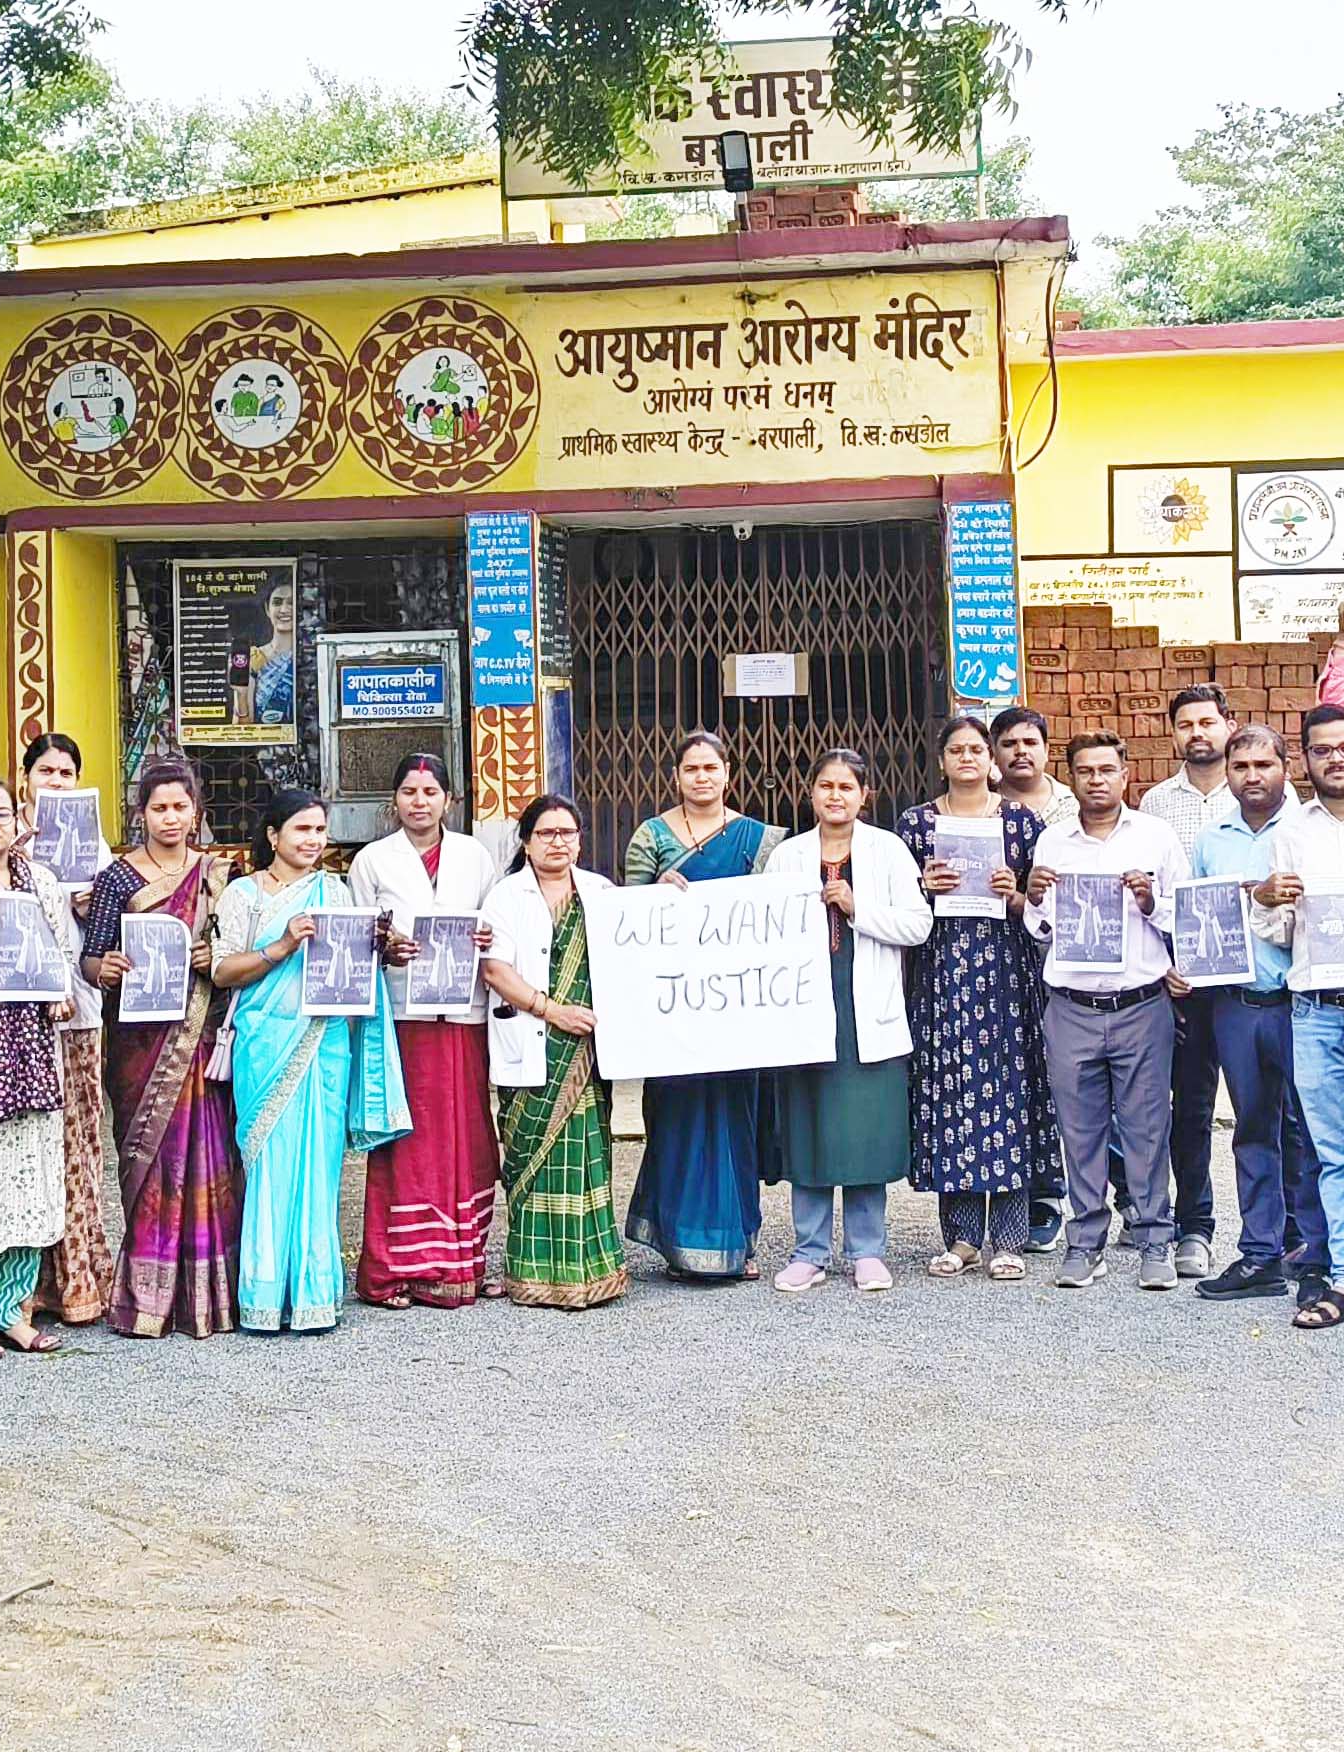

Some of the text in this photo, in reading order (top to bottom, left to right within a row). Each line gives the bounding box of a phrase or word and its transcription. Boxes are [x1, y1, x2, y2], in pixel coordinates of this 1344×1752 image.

[554, 292, 972, 393] आयुष्मान आरोग्य मंदिर
[643, 377, 713, 416] आरोग्यं
[784, 380, 837, 414] धनम्
[558, 427, 618, 460] प्राथमिक
[621, 430, 683, 453] स्वास्थ्य
[687, 421, 729, 457] केन्द्र
[347, 667, 437, 690] आपातकालीन
[614, 891, 820, 946] WE WANT
[656, 958, 814, 1015] JUSTICE
